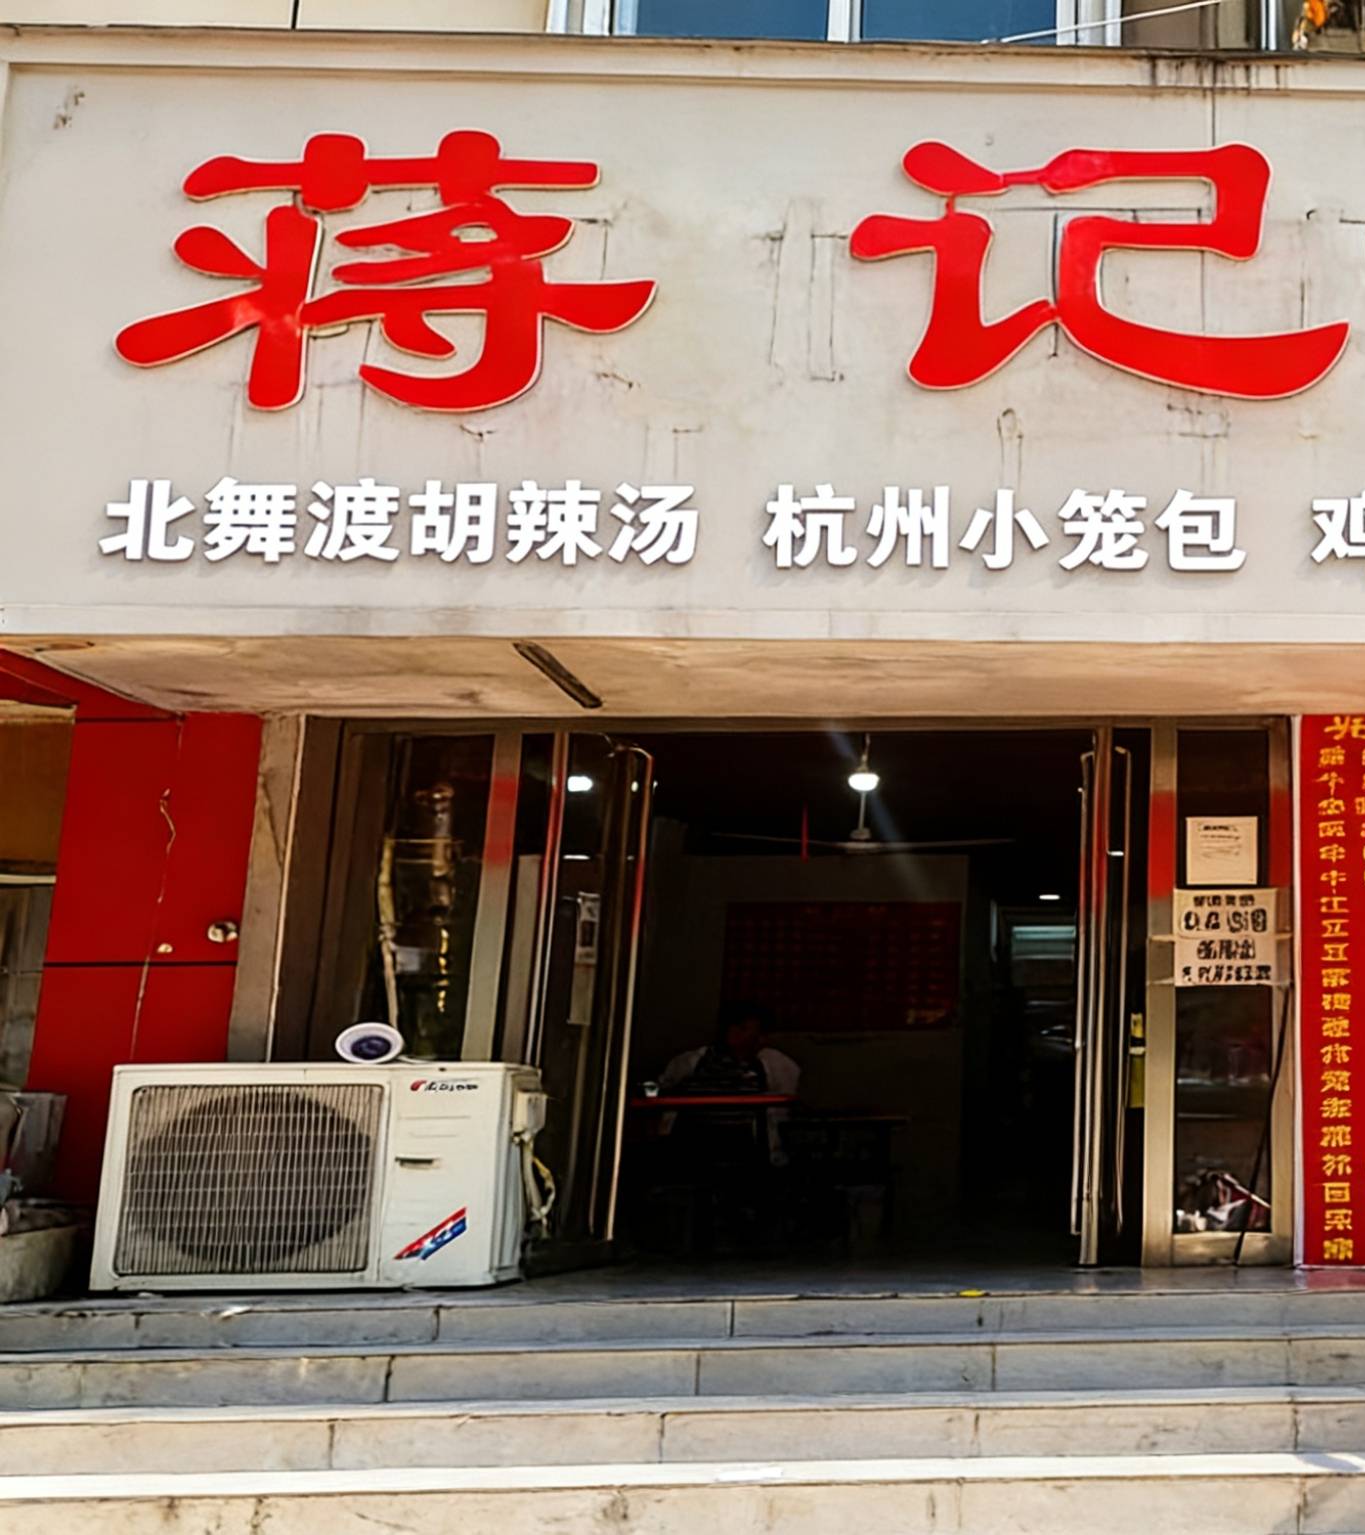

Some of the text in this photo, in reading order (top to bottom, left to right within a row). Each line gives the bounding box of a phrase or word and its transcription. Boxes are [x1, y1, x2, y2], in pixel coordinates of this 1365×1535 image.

[100, 477, 699, 568] 北舞渡胡辣汤
[763, 484, 1247, 572] 杭州小笼包
